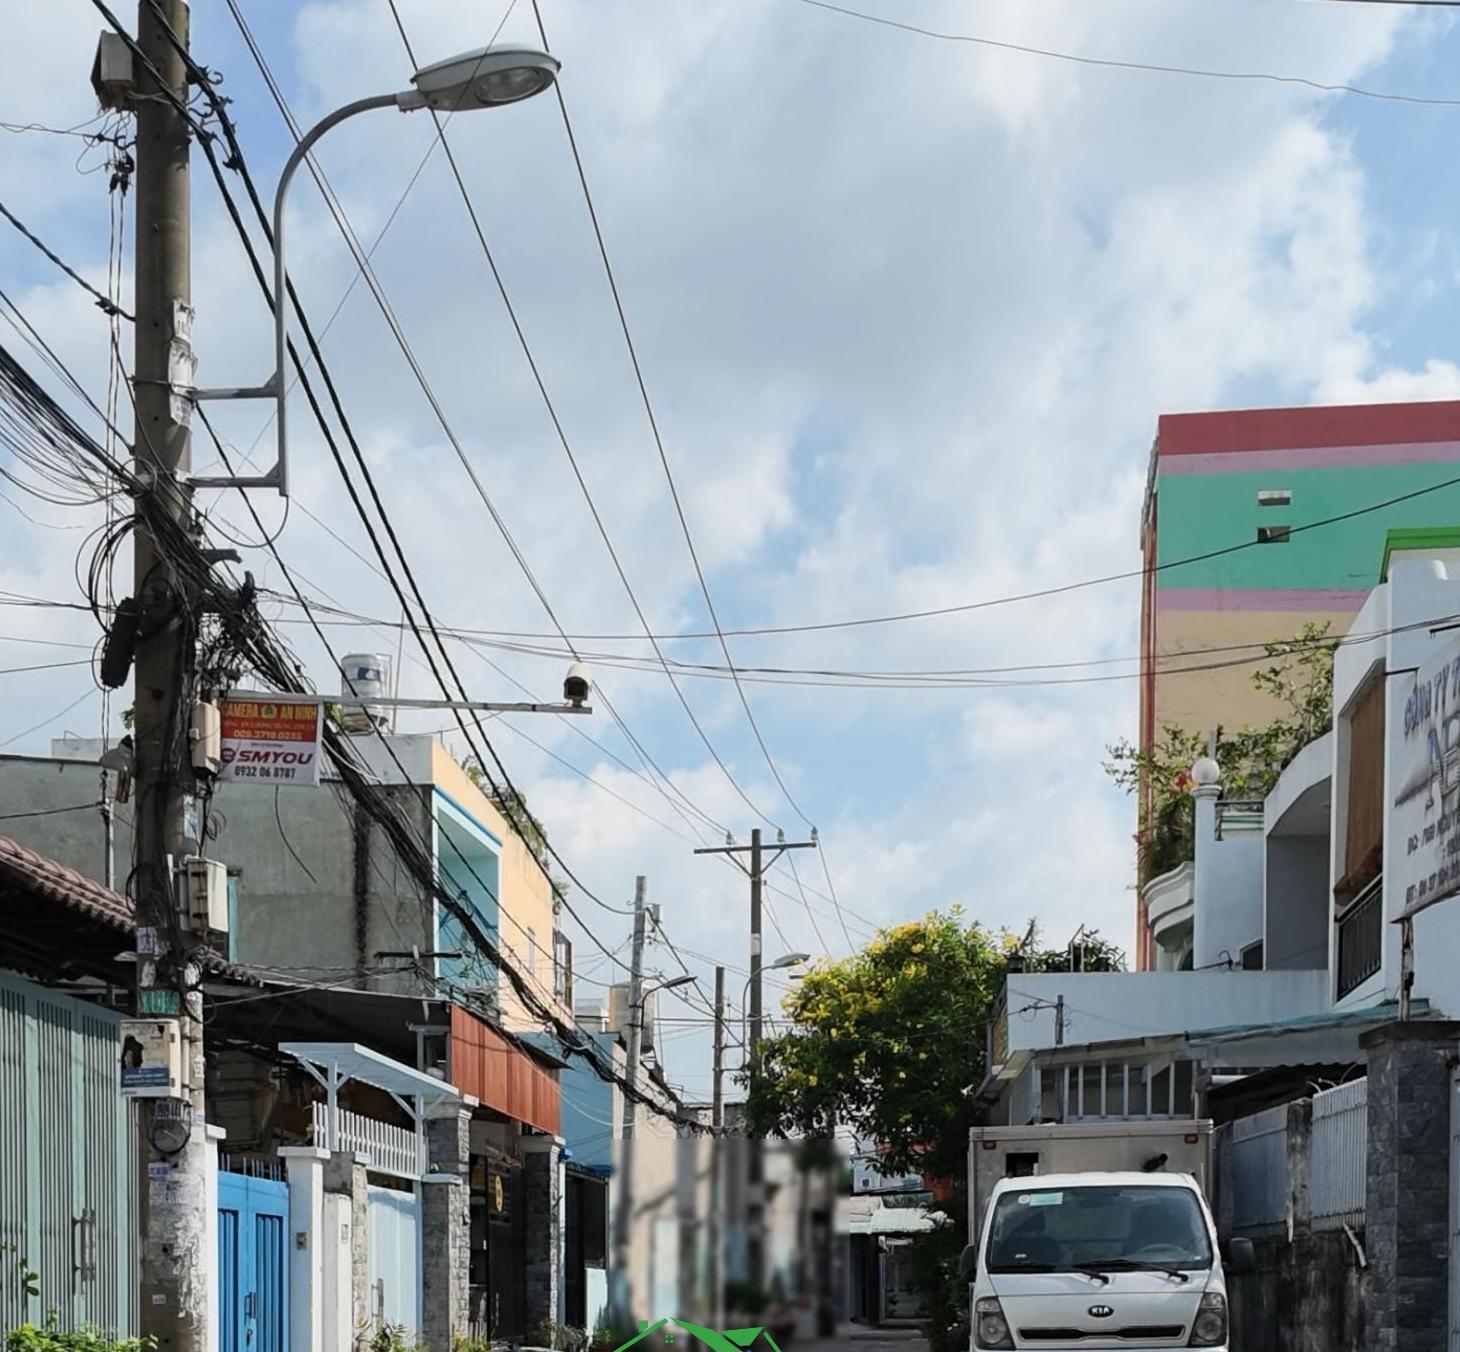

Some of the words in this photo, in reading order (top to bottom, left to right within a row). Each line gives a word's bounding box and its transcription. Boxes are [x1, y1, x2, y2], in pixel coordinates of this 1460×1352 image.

[239, 751, 313, 764] SMYOU
[235, 766, 257, 777] 0932
[260, 767, 271, 777] 06
